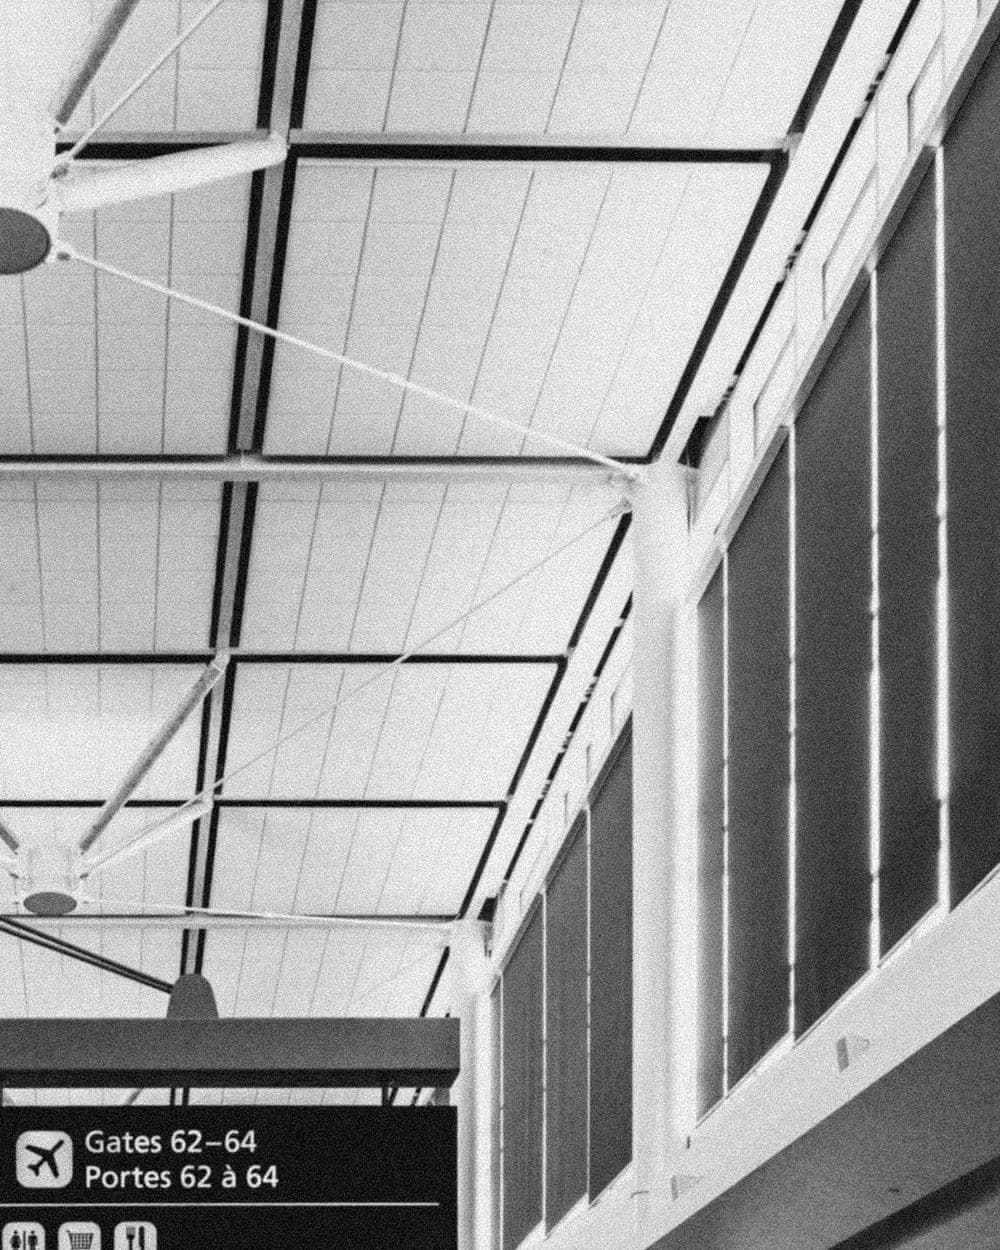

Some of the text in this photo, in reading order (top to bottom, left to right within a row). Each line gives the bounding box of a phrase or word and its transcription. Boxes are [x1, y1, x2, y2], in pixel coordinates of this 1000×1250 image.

[84, 1129, 258, 1154] Gates 62–64
[85, 1164, 279, 1189] Portes 62 à 64
